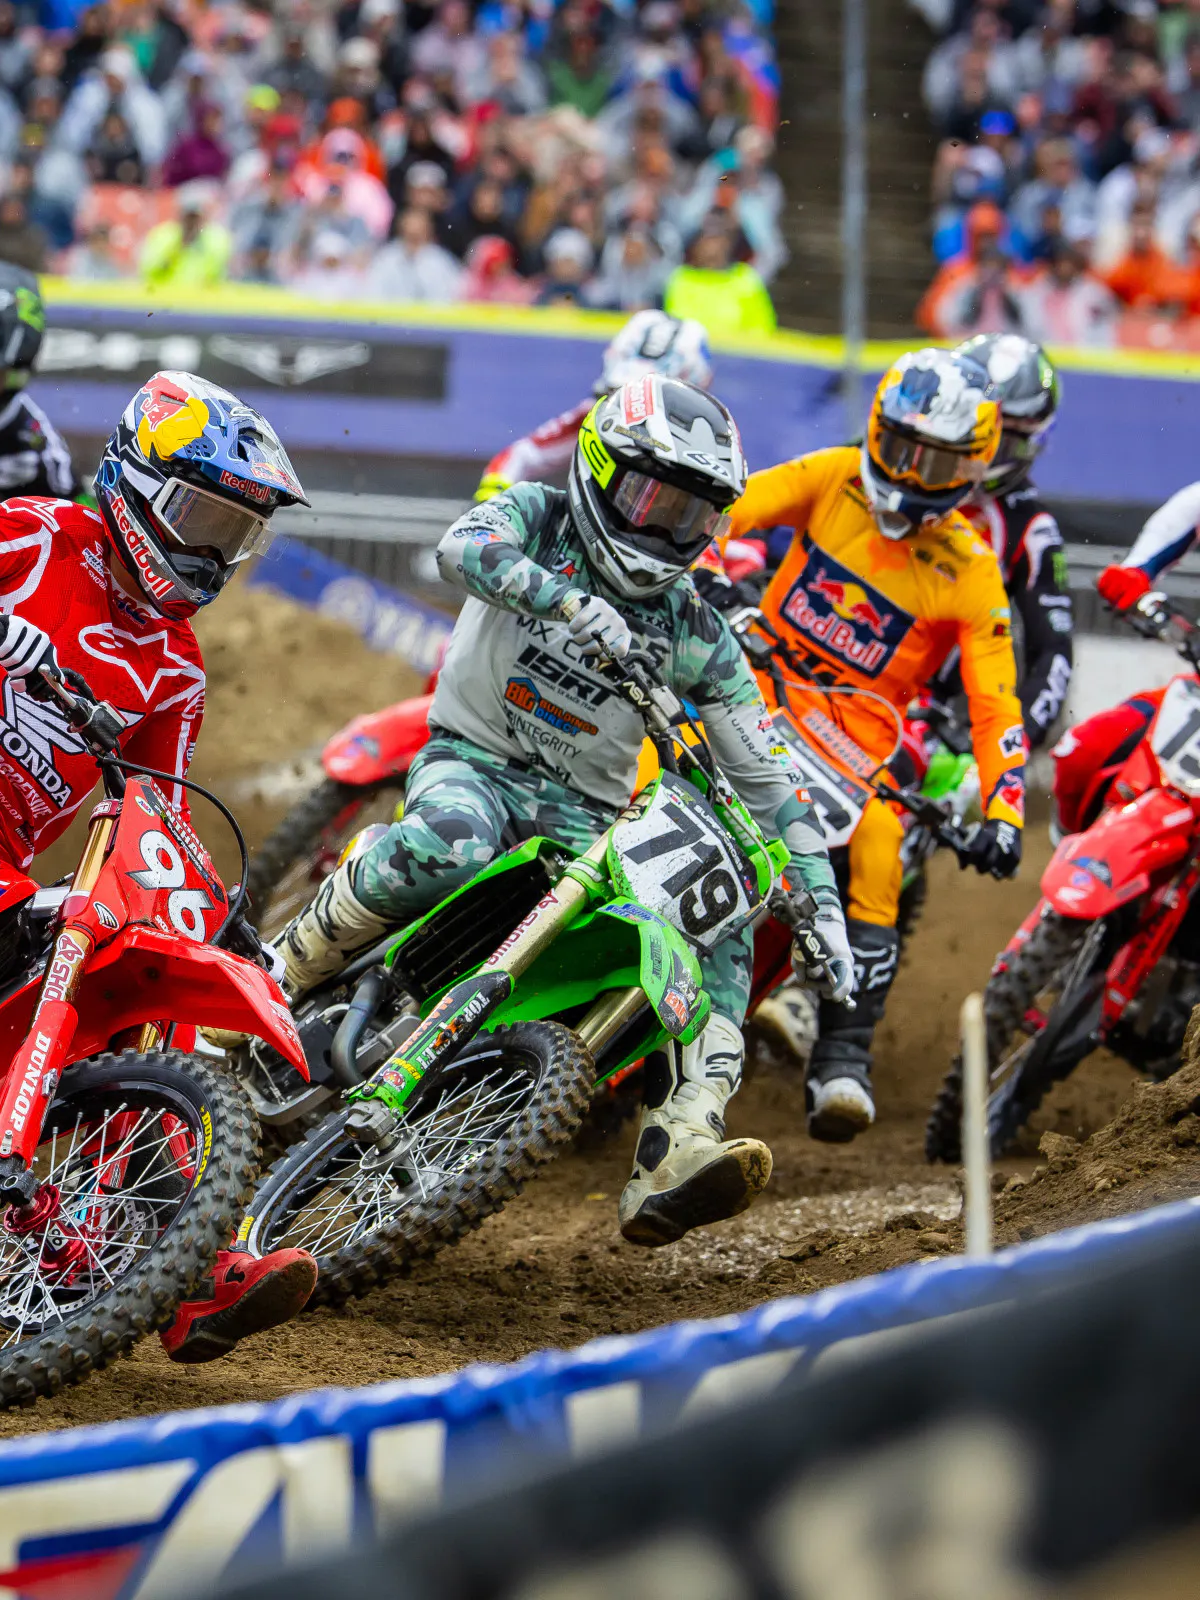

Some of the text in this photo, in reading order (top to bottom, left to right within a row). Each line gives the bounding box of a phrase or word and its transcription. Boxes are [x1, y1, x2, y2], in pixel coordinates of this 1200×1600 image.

[219, 469, 249, 493] Red
[247, 481, 272, 502] Bull
[111, 496, 146, 551] Red
[784, 587, 836, 641] Red
[825, 619, 888, 672] Bull
[505, 681, 538, 713] BIG
[539, 697, 600, 736] BUILDINGS
[579, 699, 597, 714] TEAM
[534, 707, 582, 739] DIRECT
[125, 829, 216, 944] 96
[623, 802, 738, 936] 719
[463, 991, 491, 1025] TOP
[10, 1030, 52, 1132] DUNLOP
